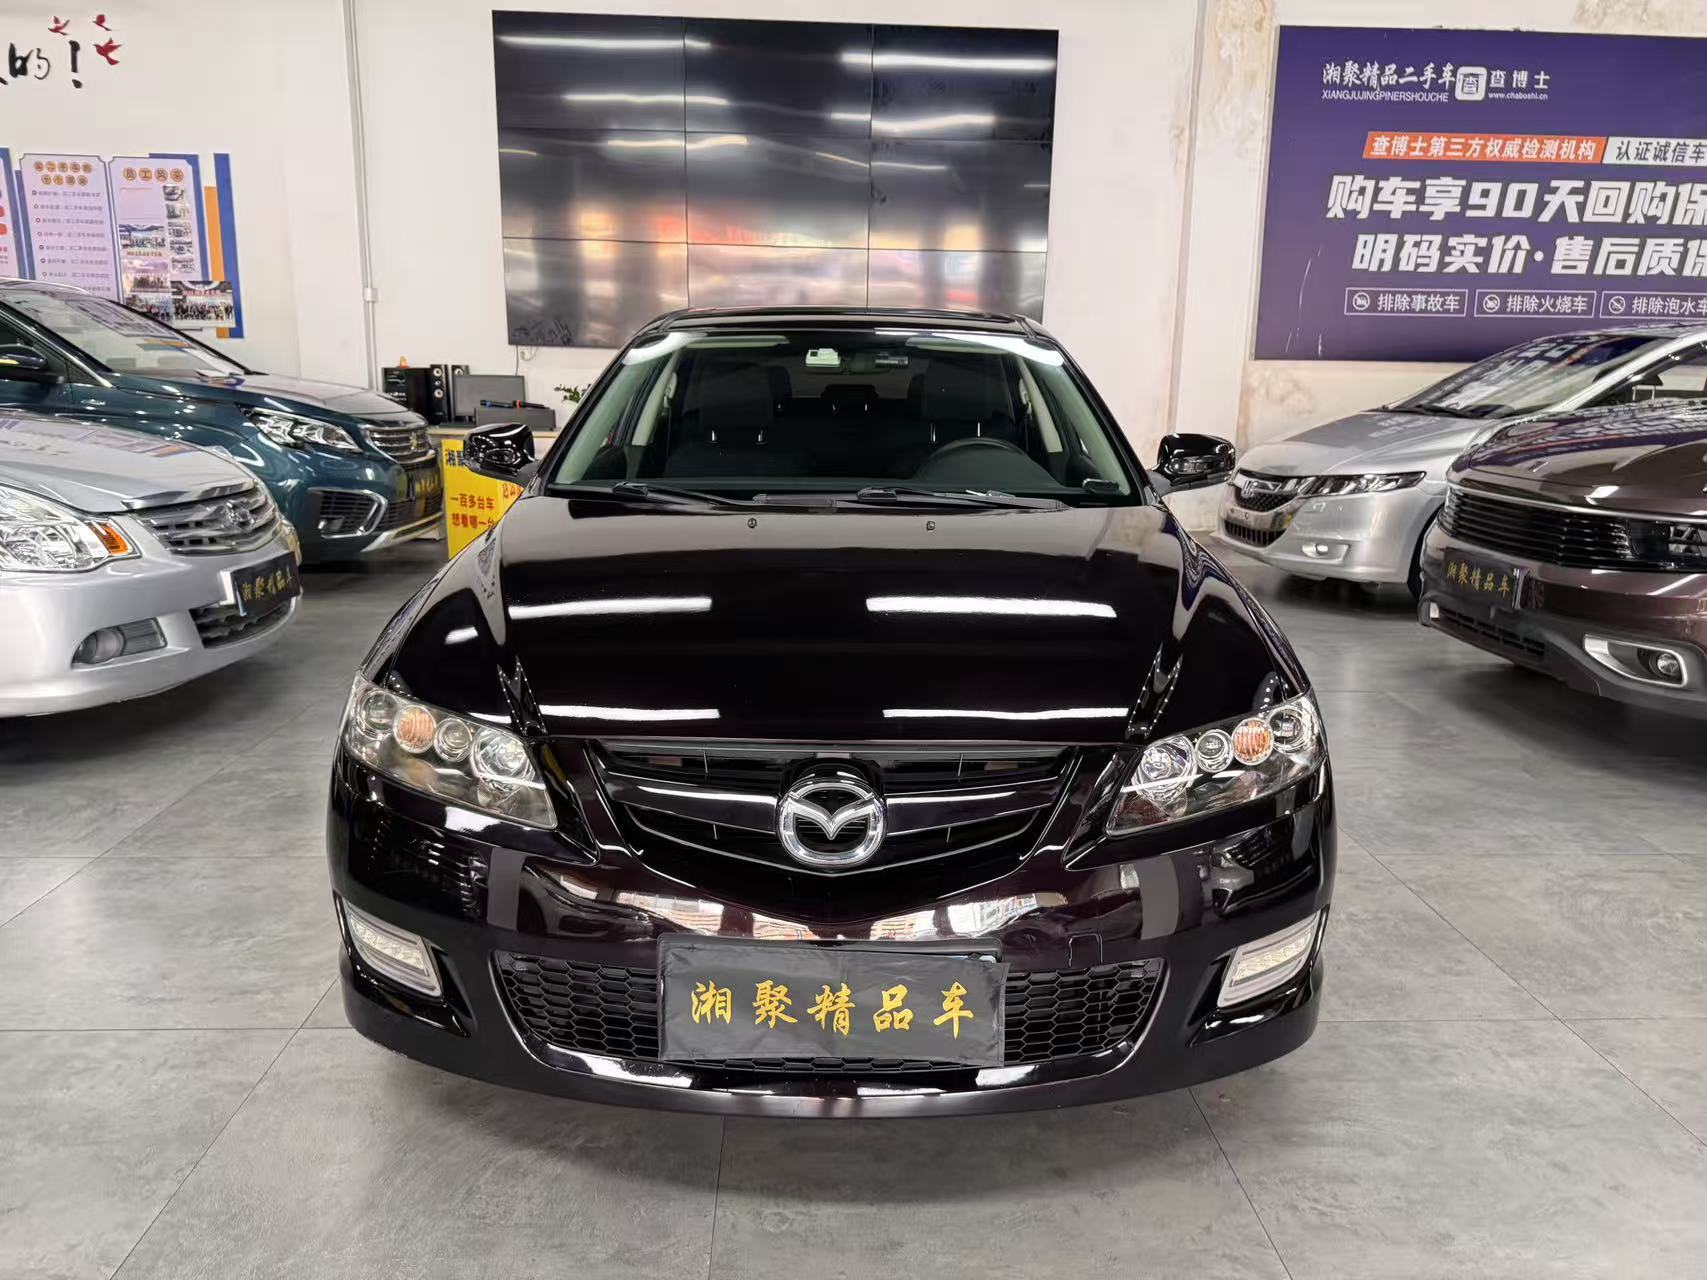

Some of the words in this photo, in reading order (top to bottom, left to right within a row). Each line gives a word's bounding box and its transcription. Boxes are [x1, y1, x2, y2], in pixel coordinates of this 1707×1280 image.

[0, 40, 83, 89] 的！
[1322, 60, 1456, 90] 湘聚精品二手车
[1489, 70, 1550, 89] 查博士
[1322, 89, 1449, 102] XIANGJUJINGPINERSHOUCHE
[1488, 91, 1549, 101] www.chaboshi.cn
[1371, 135, 1597, 160] 查博士第三方权威检测机构
[1615, 139, 1707, 163] 认证诚信车
[1377, 292, 1461, 312] 排除事故车
[1506, 294, 1588, 314] 排除火烧车
[691, 979, 975, 1040] 湘聚精品车
